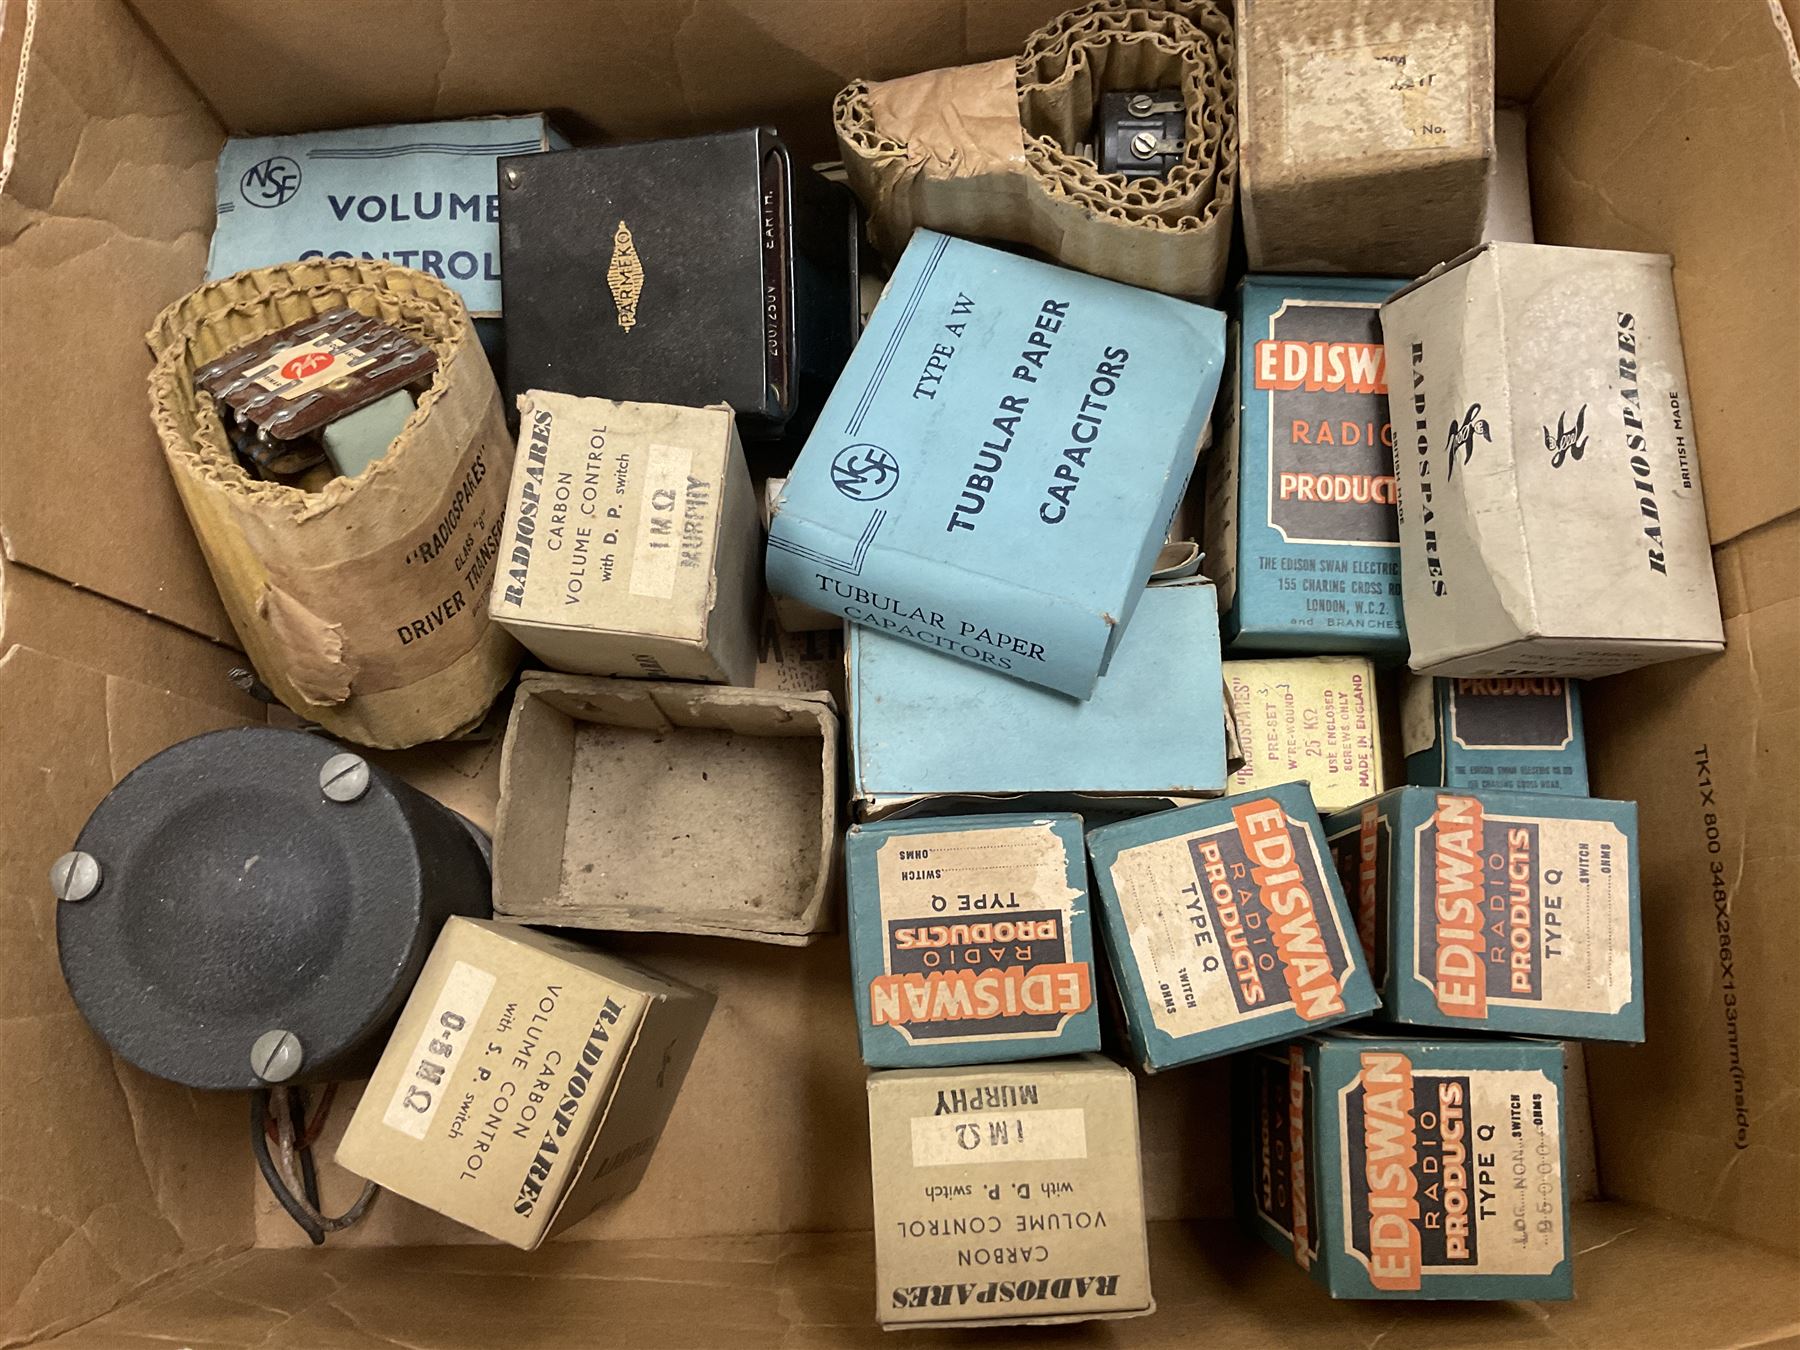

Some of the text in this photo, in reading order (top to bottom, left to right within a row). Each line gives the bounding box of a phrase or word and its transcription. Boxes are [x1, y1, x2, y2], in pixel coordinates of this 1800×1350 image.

[1422, 124, 1447, 135] No.
[243, 157, 300, 206] NSF
[327, 191, 500, 224] VOLUME
[617, 229, 637, 327] PARMEKO
[912, 342, 956, 402] TYPE
[1257, 342, 1388, 389] EDISW
[945, 297, 1071, 533] TUBULAR PAPER
[1038, 345, 1131, 526] CAPACITORS
[1615, 311, 1669, 578] RADIOSPARES
[1669, 391, 1693, 490] BRITISH MADE
[832, 445, 899, 500] NSF
[1279, 472, 1398, 504] PRODUCT
[1410, 340, 1448, 599] RADIOSPARES
[503, 409, 554, 609] RADIOSPARES
[547, 471, 574, 552] CARBON
[564, 423, 608, 606] VOLUME CONTROL
[600, 552, 614, 583] with
[615, 453, 631, 495] switch
[679, 474, 712, 570] MURPHY
[1259, 556, 1278, 571] THE
[1281, 557, 1317, 572] EDISON
[1320, 558, 1349, 574] SWAN
[1278, 577, 1298, 592] 155
[1302, 578, 1347, 594] CHARING
[1351, 579, 1383, 596] CROSS
[396, 590, 467, 646] DRIVER
[814, 573, 1047, 663] TUBULAR PAPER
[842, 605, 1014, 671] CAPACITORS
[1290, 616, 1315, 628] and
[1265, 702, 1279, 761] PRE-SET
[1324, 689, 1339, 774] USE ENCLOSED
[1338, 691, 1353, 772] SCREWS ONLY
[1352, 674, 1370, 787] MADE IN ENGLAND
[1694, 743, 1717, 807] TK1X
[899, 848, 929, 861] OHMS
[1578, 842, 1590, 885] SWITCH
[1600, 843, 1612, 875] OHMS
[1703, 812, 1721, 855] 800
[901, 868, 942, 882] SWITCH
[931, 891, 1020, 912] TYPE Q
[1437, 795, 1482, 1012] EDISWAN
[894, 918, 1059, 950] PRODUCTS
[1180, 881, 1220, 974] TYPE Q
[1198, 839, 1266, 1006] PRODUCTS
[1229, 862, 1276, 972] RADIO
[1238, 803, 1345, 1019] EDISWAN
[1488, 853, 1506, 964] RADIO
[1507, 827, 1533, 994] PRODUCTS
[1544, 868, 1564, 960] TYPE Q
[922, 944, 1032, 968] RADIO
[496, 1001, 518, 1033] with
[872, 967, 1089, 1025] EDISWAN
[1159, 979, 1177, 1015] OHMS
[459, 984, 563, 1182] VOLUME CONTROL
[512, 1049, 562, 1140] CARBON
[512, 995, 628, 1219] RADIOSPARES
[933, 1083, 1039, 1117] MURPHY
[1531, 1092, 1544, 1126] OHMS
[447, 1092, 475, 1140] switch
[1509, 1093, 1522, 1138] SWITCH
[924, 1184, 973, 1203] switch
[1040, 1182, 1074, 1195] with
[1363, 1053, 1416, 1284] EDISWAN
[1420, 1110, 1441, 1230] RADIO
[1439, 1080, 1470, 1260] PRODUCTS
[1476, 1123, 1497, 1221] TYPE Q
[896, 1211, 1108, 1239] VOLUME CONTROL
[957, 1245, 1049, 1266] CARBON
[891, 1274, 1121, 1309] RADIOSPARES
